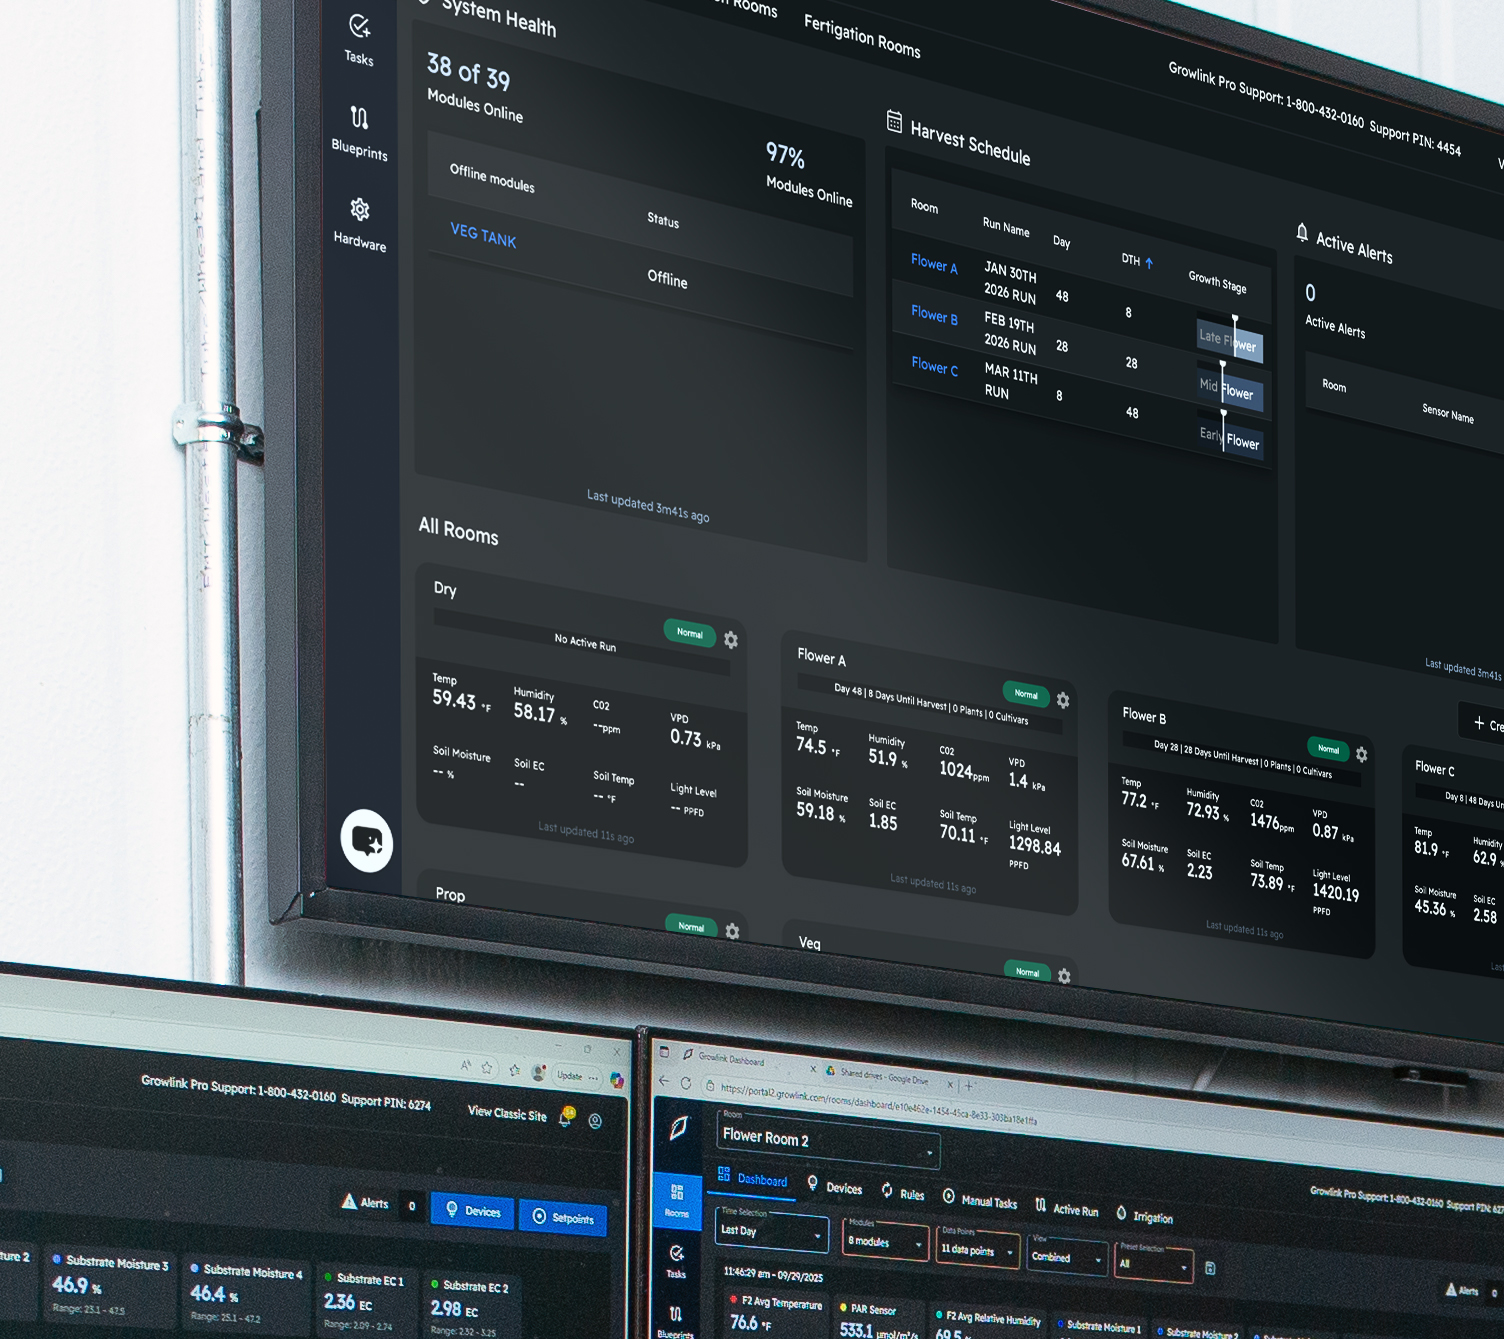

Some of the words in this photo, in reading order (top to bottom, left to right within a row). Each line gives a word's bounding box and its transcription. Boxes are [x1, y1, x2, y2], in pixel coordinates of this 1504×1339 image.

[442, 0, 501, 23] System
[506, 10, 556, 38] Health
[734, 0, 777, 18] Rooms
[805, 14, 874, 45] Fertigation
[878, 35, 921, 59] Rooms
[344, 49, 374, 67] Tasks
[427, 52, 451, 76] 38
[459, 63, 480, 84] of
[487, 67, 510, 91] 39
[428, 88, 480, 112] Modules
[484, 103, 523, 123] Online
[1169, 61, 1215, 85] Growlink
[1219, 75, 1236, 91] Pro
[1239, 82, 1283, 105] Support:
[1287, 96, 1364, 128] 1-800-432-0160
[1370, 120, 1410, 142] Support
[1413, 133, 1434, 149] PIN:
[1437, 141, 1461, 157] 4454
[332, 138, 388, 162] Blueprints
[911, 120, 965, 148] Harvest
[969, 137, 1030, 166] Schedule
[766, 141, 805, 169] 97%
[450, 163, 487, 182] Offline
[490, 175, 535, 193] modules
[648, 212, 679, 229] Status
[983, 217, 1001, 230] Run
[1003, 222, 1030, 238] Name
[334, 231, 386, 253] Hardware
[451, 222, 478, 239] VEG
[481, 229, 516, 249] TANK
[1316, 232, 1354, 254] Active
[1358, 243, 1393, 264] Alerts
[1122, 253, 1140, 266] DTH
[648, 269, 688, 289] Offline
[985, 261, 1006, 276] JAN
[1010, 267, 1036, 283] 30TH
[1189, 270, 1220, 287] Growth
[1223, 279, 1247, 295] Stage
[419, 516, 438, 534] All
[444, 521, 498, 546] Rooms
[434, 581, 457, 599] Dry
[555, 633, 568, 644] No
[570, 636, 597, 649] Active
[600, 641, 616, 652] Run
[677, 627, 703, 639] Normal
[798, 647, 835, 664] Flower
[838, 655, 846, 667] A
[433, 689, 476, 710] 59.43
[514, 687, 554, 703] Humidity
[514, 702, 555, 723] 58.17
[1123, 707, 1157, 722] Flower
[1160, 713, 1166, 725] B
[671, 728, 701, 747] 0.73
[796, 736, 826, 755] 74.5
[1122, 790, 1147, 808] 77.2
[1187, 801, 1219, 820] 72.93
[1415, 840, 1438, 856] 81.9
[723, 1127, 762, 1142] Flower
[765, 1131, 799, 1146] Room
[801, 1135, 809, 1147] 2
[553, 1213, 594, 1225] Setpoints
[1134, 1211, 1173, 1225] Irrigation
[731, 1314, 758, 1330] 76.6
[840, 1322, 873, 1339] 533.1
